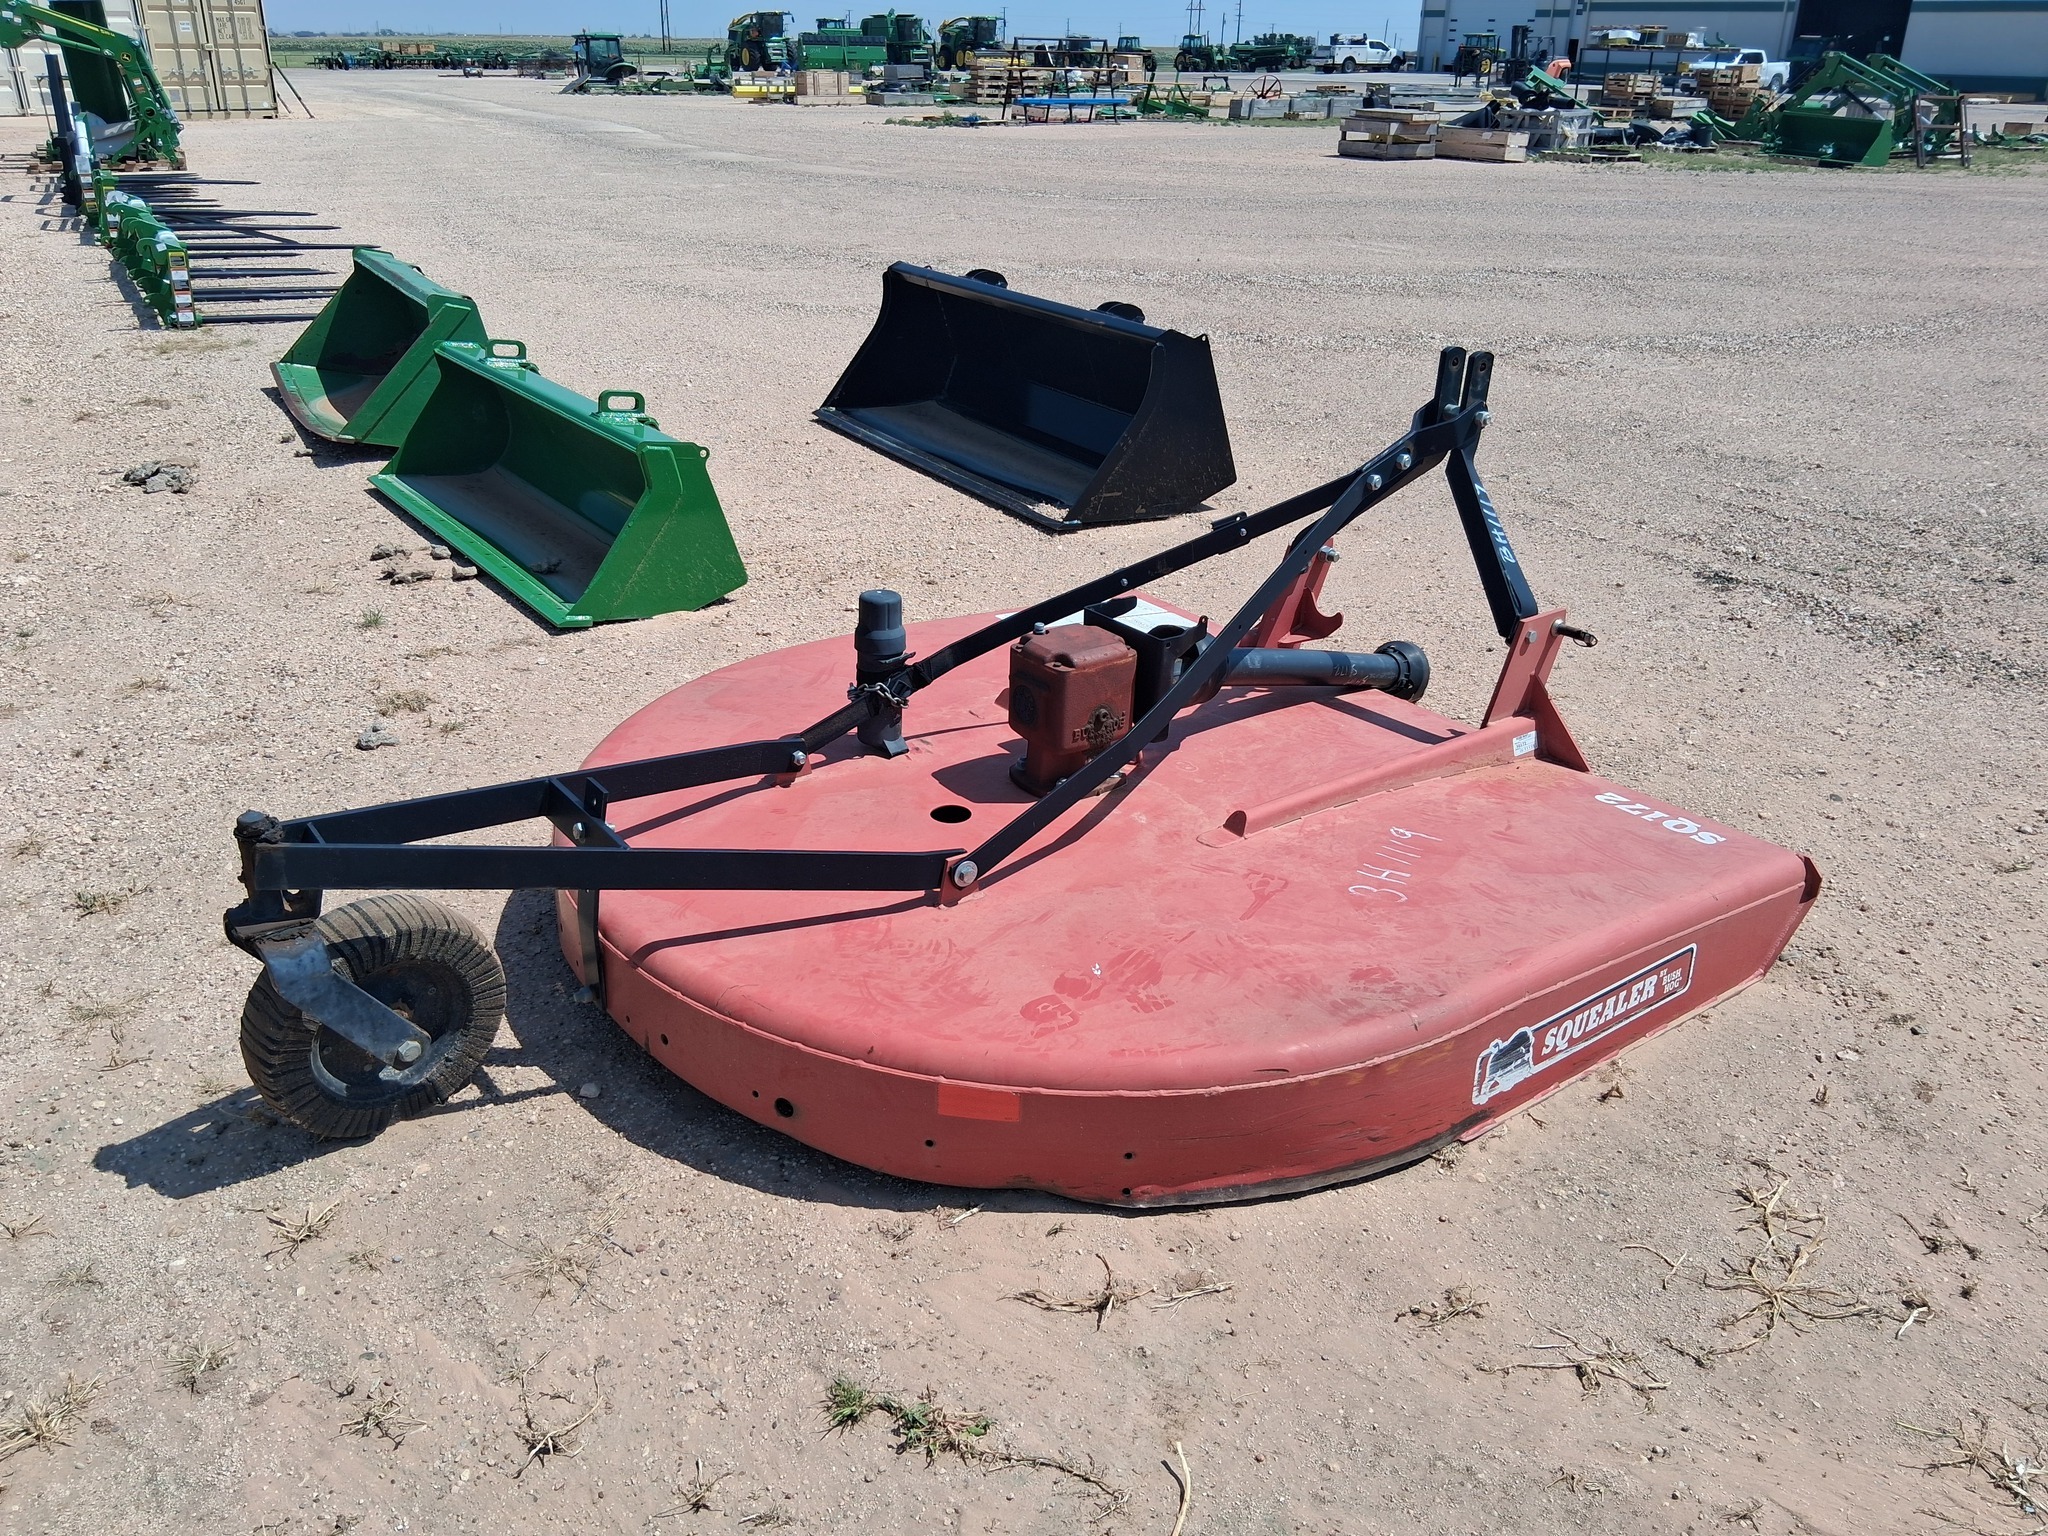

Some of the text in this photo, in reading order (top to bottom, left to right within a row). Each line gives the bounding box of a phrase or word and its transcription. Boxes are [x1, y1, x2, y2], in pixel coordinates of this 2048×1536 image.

[1594, 792, 1728, 845] SQ172
[1660, 968, 1668, 977] BY
[1662, 968, 1682, 985] BUSH
[1541, 974, 1658, 1056] SQUEALER
